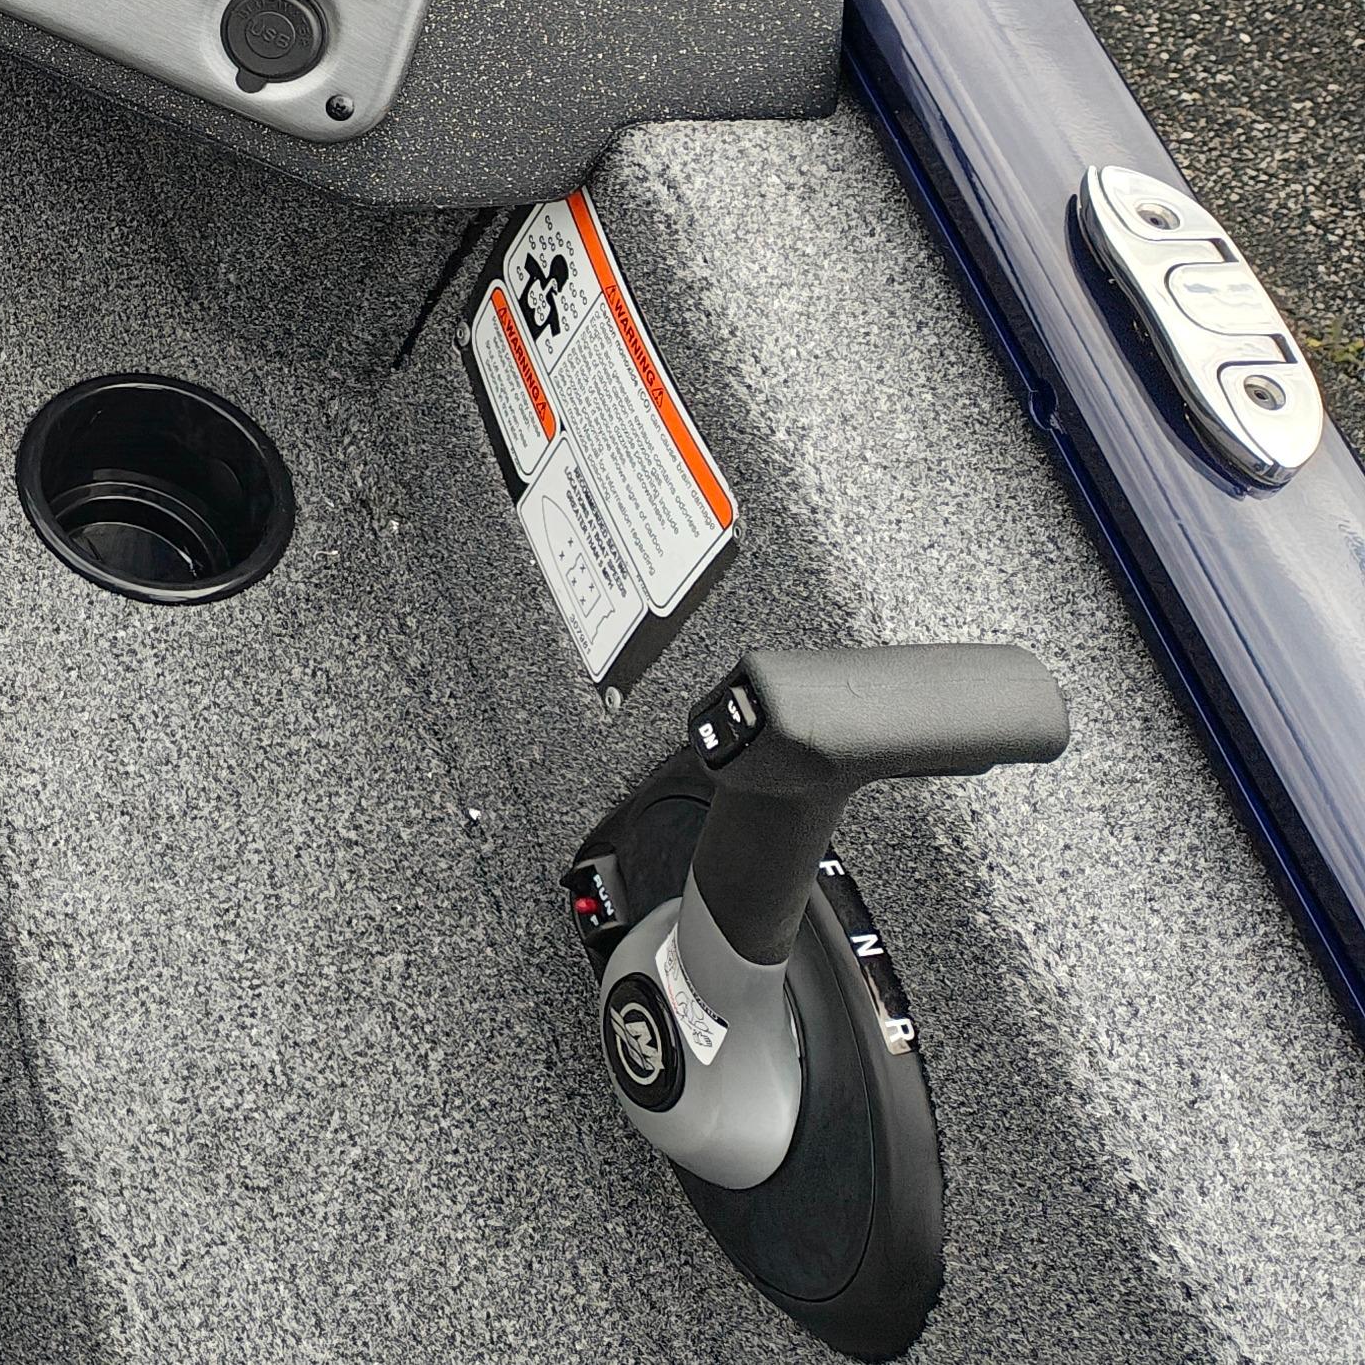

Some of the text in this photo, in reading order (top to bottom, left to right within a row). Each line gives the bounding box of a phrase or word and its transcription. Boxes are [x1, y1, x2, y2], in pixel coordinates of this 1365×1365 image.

[248, 17, 291, 49] USB
[505, 319, 539, 402] WARNING
[613, 299, 655, 387] WARNING
[599, 302, 715, 533] Carbon monoxide (CO) can cause brain damage
[573, 465, 608, 538] RECOMMENDED
[564, 465, 626, 598] LOCATIONS AT BOAT SPEEDS
[565, 489, 587, 533] GREATER
[586, 533, 599, 561] THAN
[601, 566, 613, 590] MPH
[644, 520, 664, 558] carbon
[698, 723, 719, 750] DN
[819, 859, 845, 876] F
[850, 933, 885, 957] N
[885, 1018, 915, 1043] R
